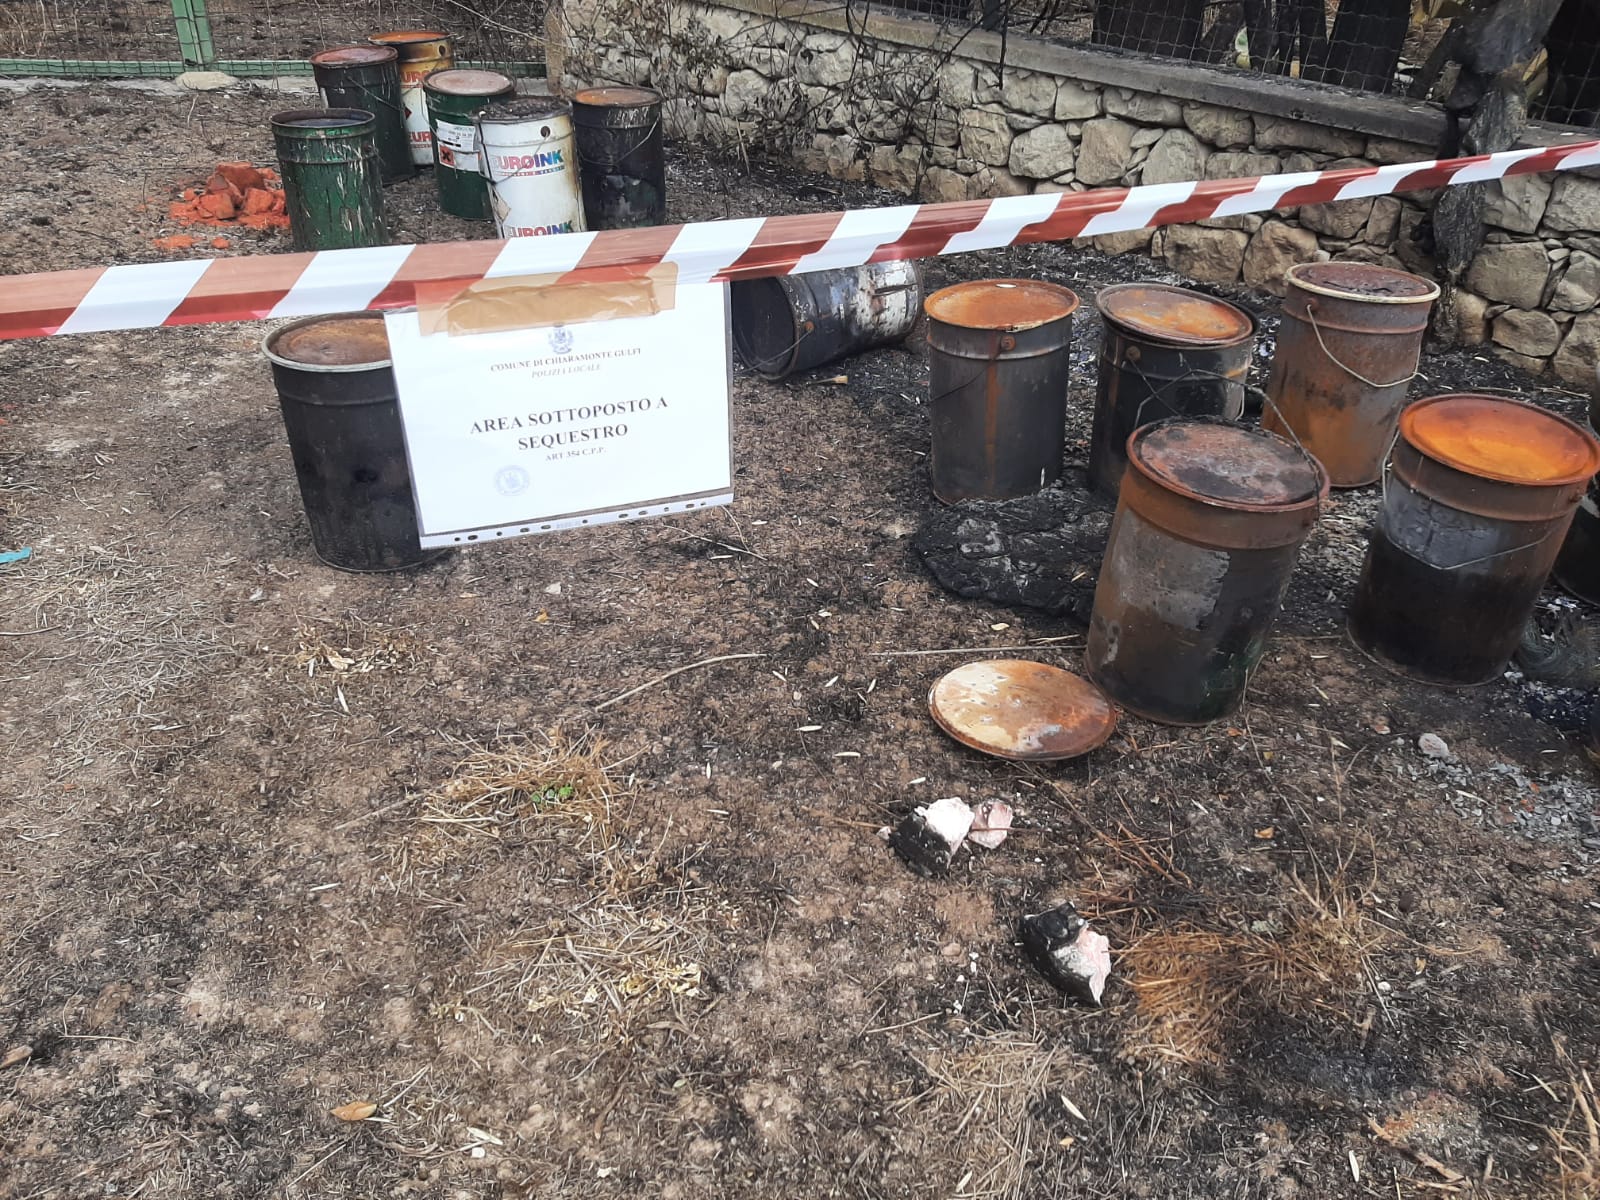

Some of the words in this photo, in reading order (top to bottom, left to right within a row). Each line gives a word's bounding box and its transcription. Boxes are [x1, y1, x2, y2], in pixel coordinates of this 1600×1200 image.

[490, 360, 531, 372] COMUNE
[533, 358, 543, 368] DI
[545, 350, 612, 366] CHIARAMONTE
[614, 347, 641, 358] GULFI
[568, 363, 601, 374] LOCALE
[469, 416, 523, 435] AREA
[528, 397, 652, 427] SOTTOPOSTO
[656, 396, 669, 409] A
[517, 423, 629, 451] SEQUESTRO
